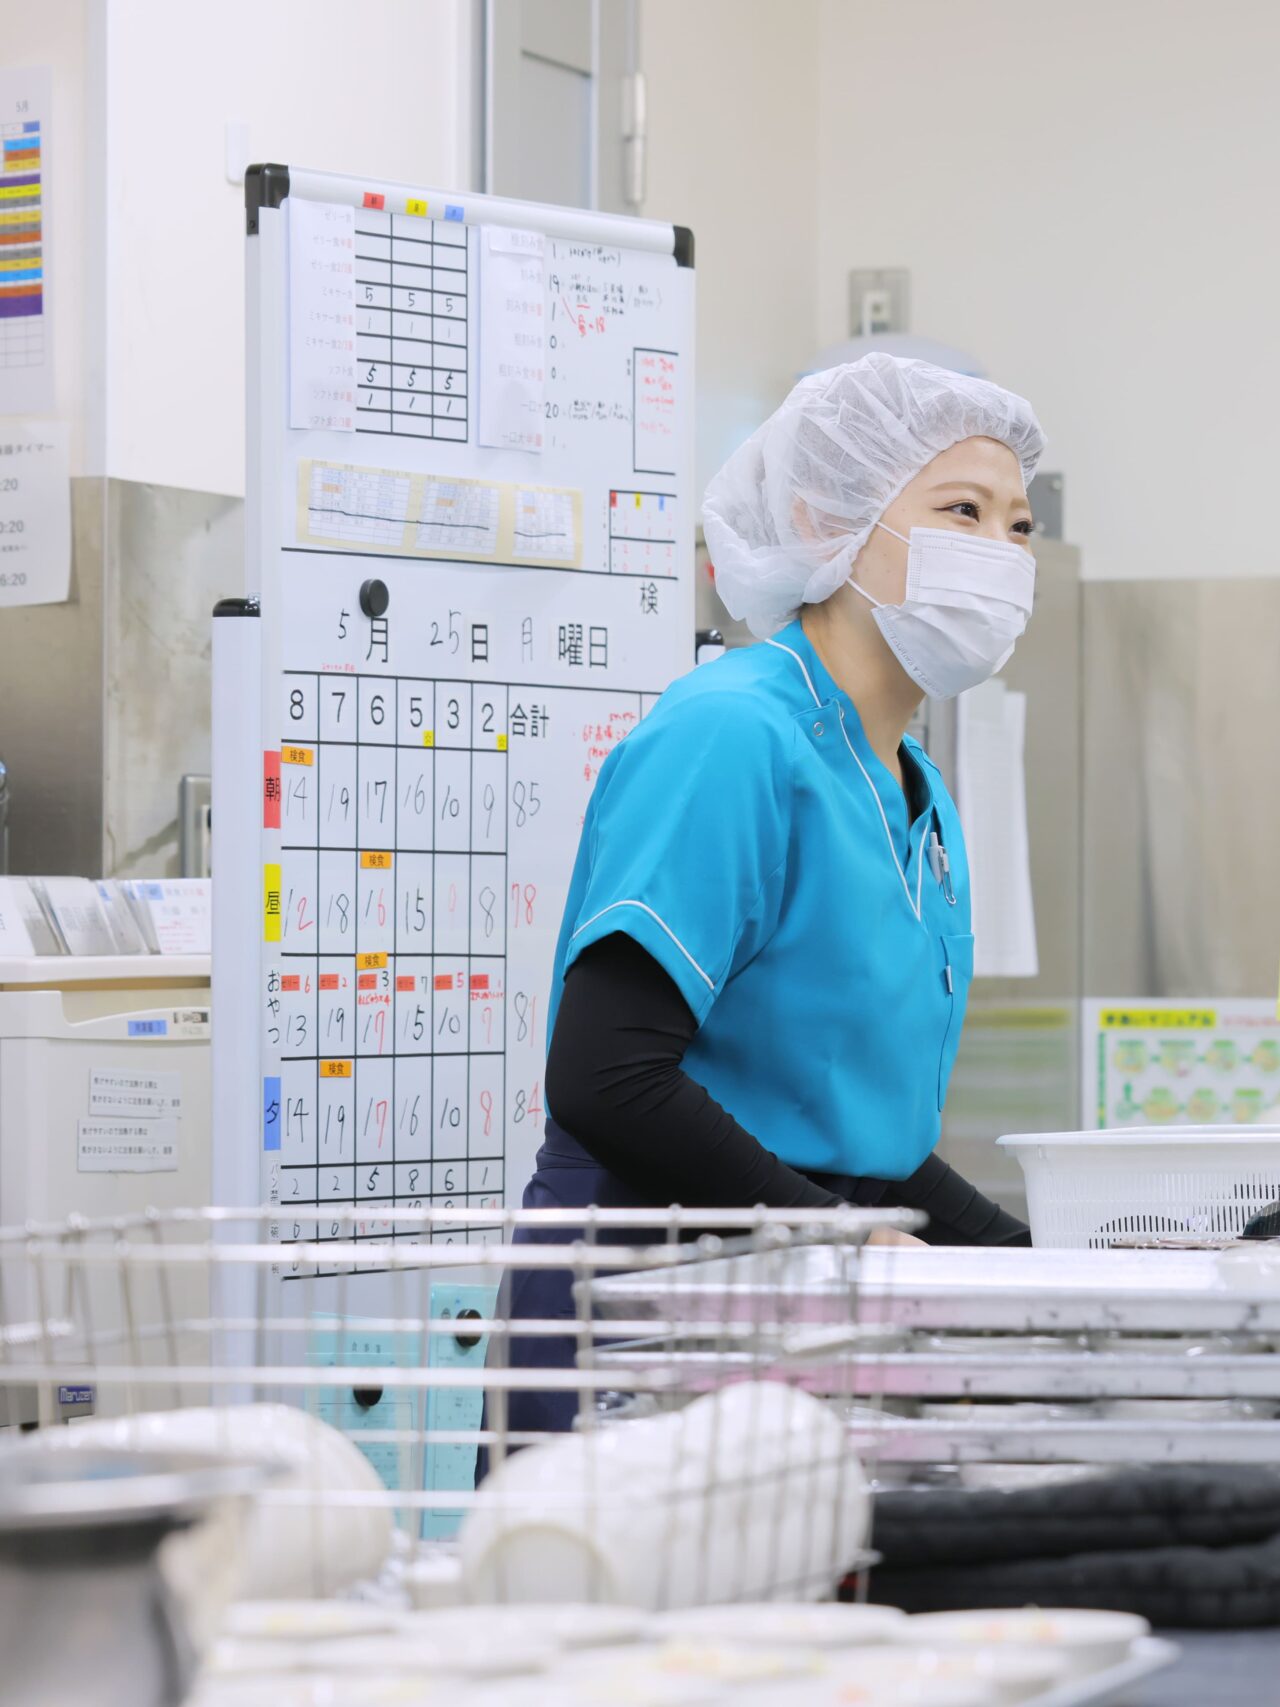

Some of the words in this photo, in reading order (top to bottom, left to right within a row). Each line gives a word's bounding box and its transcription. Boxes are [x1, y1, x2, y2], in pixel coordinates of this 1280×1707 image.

[365, 286, 374, 302] 5
[408, 292, 416, 307] 5
[445, 298, 453, 312] 5
[550, 335, 557, 349] 0
[366, 364, 376, 382] 5
[407, 368, 416, 387] 5
[444, 371, 453, 390] 5
[545, 401, 560, 418] 20
[640, 581, 658, 615] 検
[366, 617, 389, 663] 月
[558, 623, 608, 669] 曜日
[290, 689, 304, 720] 8
[332, 692, 346, 723] 7
[370, 695, 384, 725] 6
[410, 697, 423, 727] 5
[447, 699, 460, 729] 3
[481, 702, 495, 732] 2
[510, 703, 550, 738] 合計
[286, 776, 309, 821] 14
[328, 783, 349, 822] 19
[366, 780, 387, 824] 17
[404, 774, 425, 815] 16
[441, 784, 460, 821] 10
[483, 783, 495, 838] 9
[512, 781, 541, 828] 85
[369, 854, 385, 867] 検食
[284, 888, 314, 936] 12
[326, 893, 350, 934] 18
[365, 887, 385, 927] 16
[406, 886, 425, 935] 15
[479, 886, 496, 938] 8
[511, 882, 537, 929] 78
[365, 954, 380, 967] 検食
[305, 975, 311, 994] 6
[382, 970, 390, 987] 3
[421, 976, 428, 995] 7
[457, 971, 464, 988] 5
[267, 969, 280, 1044] おやつ
[286, 1015, 307, 1047] 13
[327, 1007, 345, 1042] 19
[363, 1010, 385, 1055] 17
[403, 1004, 425, 1041] 15
[438, 1007, 461, 1034] 10
[514, 992, 536, 1048] 81
[329, 1062, 345, 1075] 検食
[286, 1097, 309, 1143] 14
[324, 1104, 345, 1154] 19
[363, 1097, 387, 1149] 17
[400, 1095, 420, 1136] 16
[440, 1098, 461, 1129] 10
[480, 1090, 493, 1137] 8
[513, 1080, 543, 1128] 84
[292, 1178, 300, 1195] 2
[332, 1175, 341, 1191] 2
[366, 1167, 380, 1191] 5
[409, 1168, 419, 1191] 8
[445, 1169, 454, 1191] 6
[482, 1166, 489, 1185] 1
